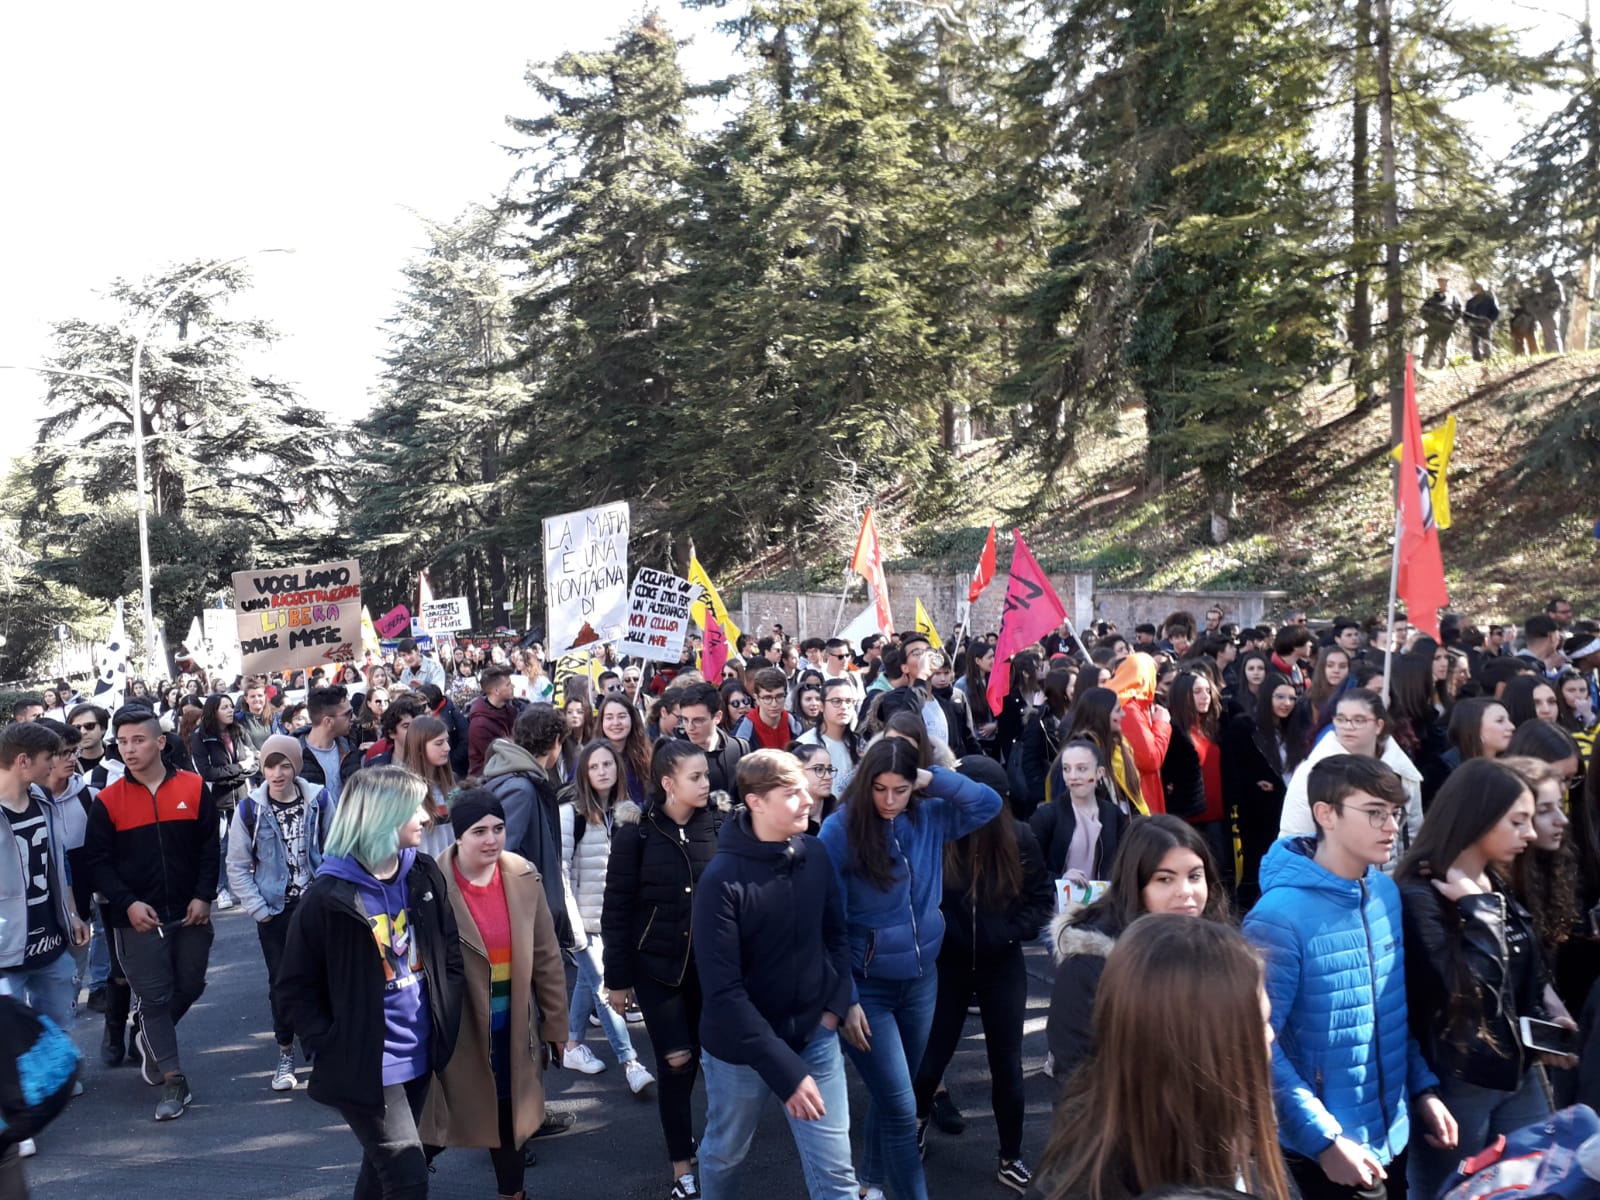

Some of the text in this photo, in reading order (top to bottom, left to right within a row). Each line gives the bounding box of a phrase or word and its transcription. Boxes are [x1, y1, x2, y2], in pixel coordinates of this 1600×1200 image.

[548, 511, 628, 550] LA MAFIA
[562, 538, 617, 573] È UNA
[550, 565, 624, 608] MONTAGNA
[640, 568, 692, 593] VOGLIAMO UN
[240, 597, 270, 612] UNA
[581, 597, 595, 615] DI
[635, 584, 691, 607] CODICE ETICO PER
[628, 613, 679, 632] NON COLLUSA
[240, 634, 279, 656] DALLE
[648, 634, 667, 647] MAFIE
[25, 933, 62, 958] attoo
